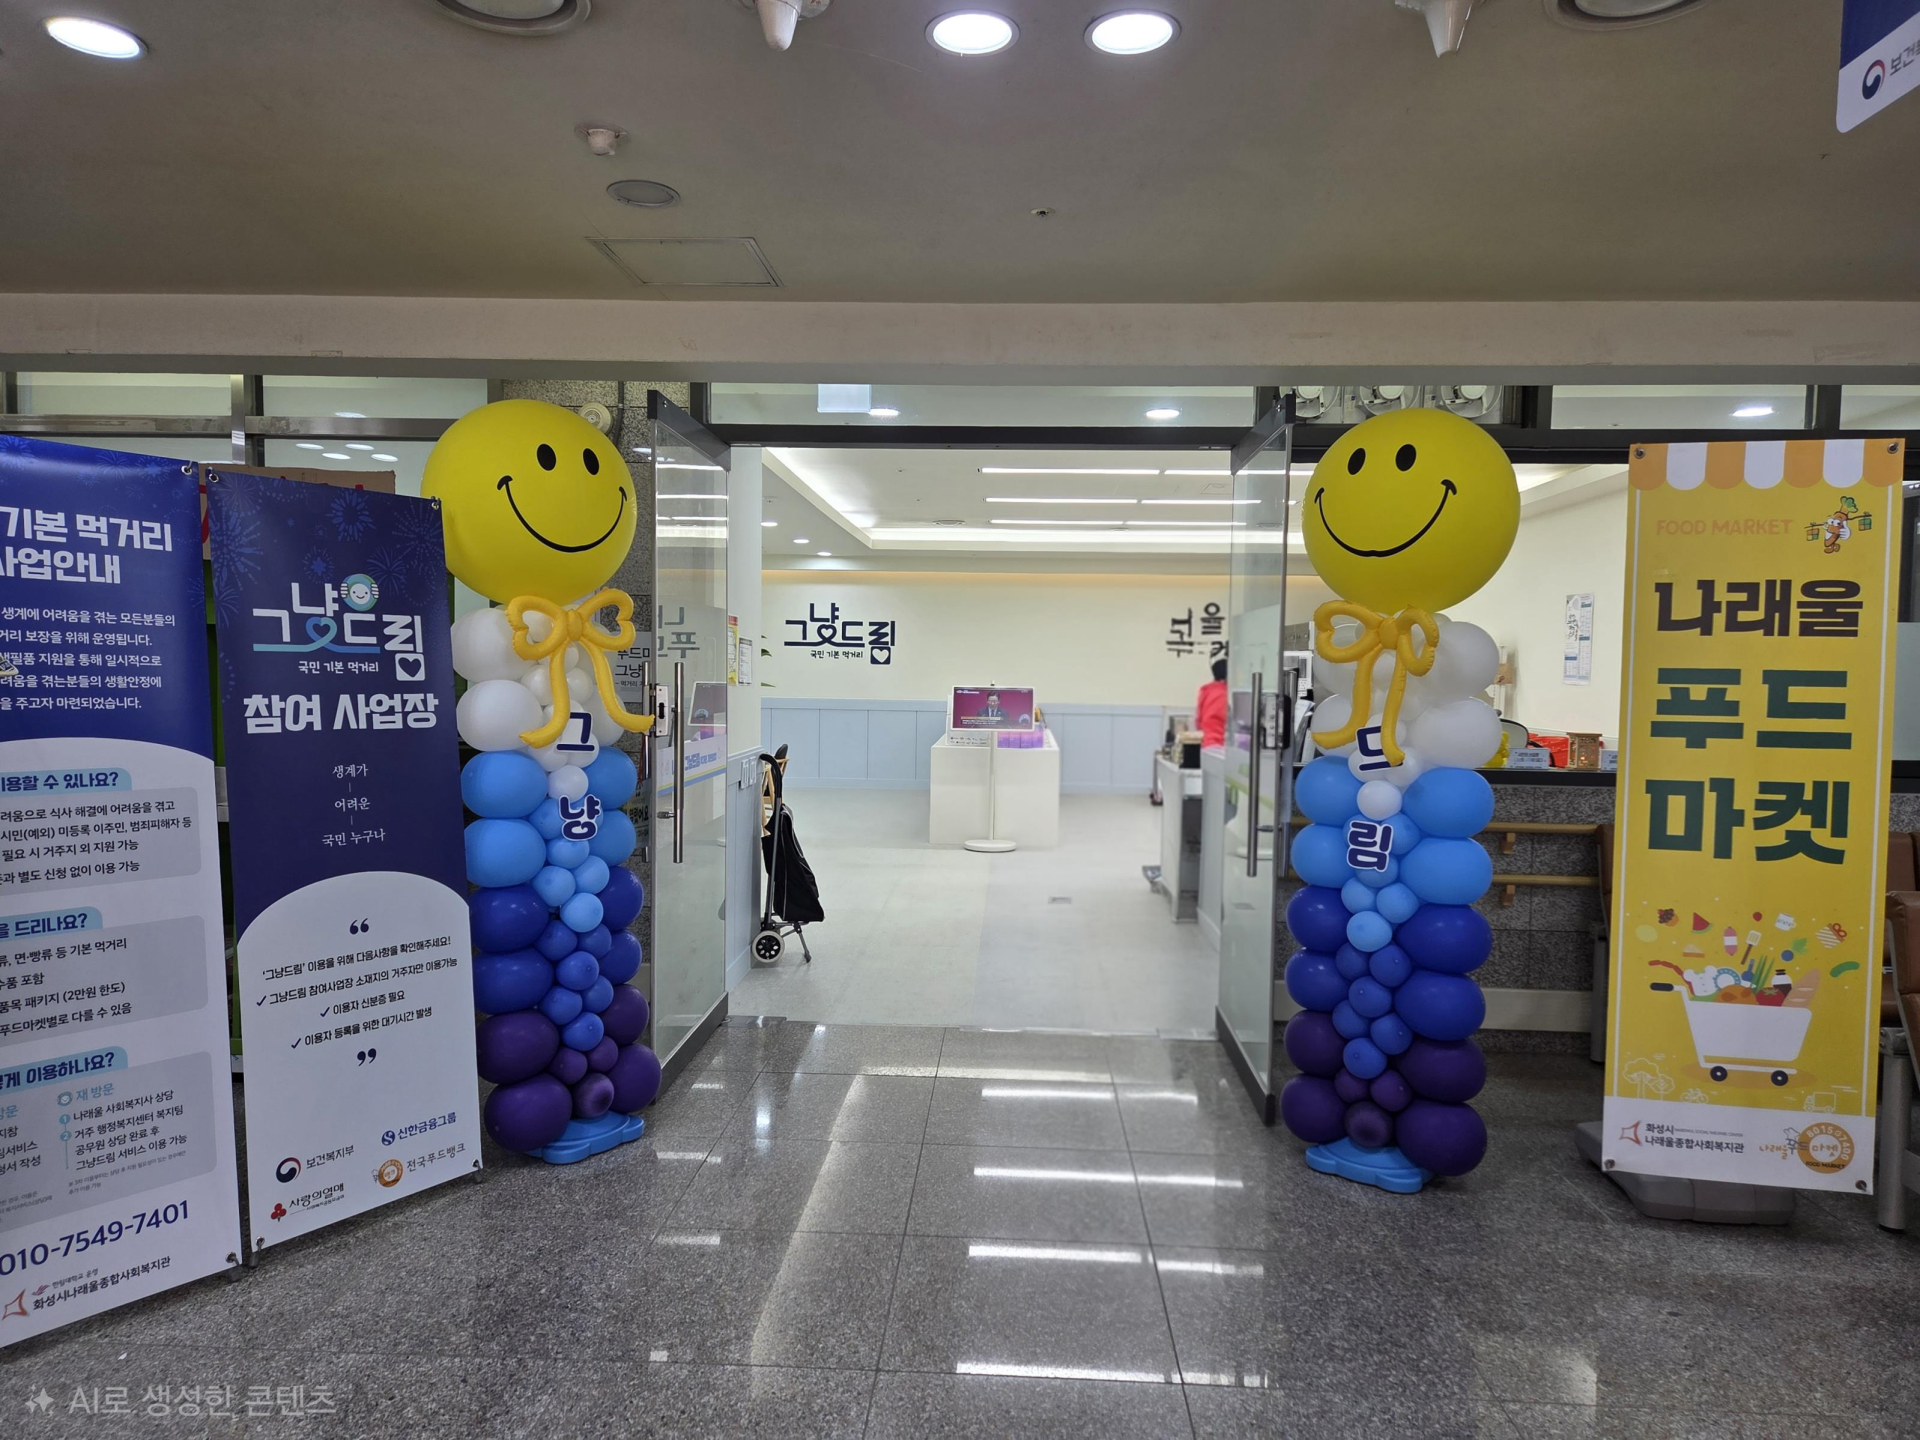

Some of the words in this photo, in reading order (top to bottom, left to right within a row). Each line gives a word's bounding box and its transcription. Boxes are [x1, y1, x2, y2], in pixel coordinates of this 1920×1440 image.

[0, 506, 68, 543] 기본
[76, 514, 172, 552] 먹거리
[1657, 519, 1706, 536] FOOD
[1711, 518, 1793, 536] MARKET
[2, 607, 40, 620] 생계에
[42, 609, 91, 622] 어려움을
[94, 611, 118, 624] 겪는
[120, 612, 175, 626] 모든분들의
[1654, 578, 1863, 637] 나래울
[25, 631, 62, 643] 보장을
[66, 632, 89, 644] 위해
[92, 633, 152, 646] 운영됩니다.
[252, 582, 426, 681] 그냥드림
[784, 602, 896, 665] 그냥드림
[39, 652, 75, 666] 지원을
[78, 654, 102, 666] 통해
[105, 654, 162, 666] 일시적으로
[810, 650, 824, 659] 국민
[827, 650, 840, 659] 기본
[842, 650, 863, 659] 먹거리
[298, 661, 320, 674] 국민
[324, 661, 344, 674] 기본
[348, 661, 379, 674] 먹거리
[42, 675, 101, 688] 겪는분들의
[105, 676, 162, 688] 생활안정에
[16, 698, 54, 710] 주고자
[57, 698, 142, 710] 마련되었습니다.
[243, 694, 322, 734] 참여
[333, 692, 439, 730] 사업장
[1650, 667, 1852, 750] 푸드
[43, 774, 59, 790] 수
[63, 771, 119, 789] 있나요?
[332, 764, 369, 779] 생계가
[50, 807, 72, 820] 식사
[75, 805, 108, 818] 해결에
[110, 801, 152, 815] 어려움을
[155, 800, 175, 812] 겪고
[334, 797, 370, 812] 어려운
[58, 825, 91, 837] 미등록
[93, 821, 127, 835] 이주민,
[130, 819, 180, 832] 범죄피해자
[182, 817, 192, 829] 등
[1645, 777, 1851, 865] 마켓
[322, 832, 346, 847] 국민
[350, 828, 386, 845] 누구나
[2, 848, 26, 861] 필요
[29, 847, 41, 859] 시
[43, 845, 77, 857] 거주지
[80, 843, 90, 855] 외
[93, 841, 115, 853] 지원
[118, 839, 139, 851] 가능
[18, 869, 40, 883] 별도
[45, 867, 67, 881] 신청
[70, 865, 91, 878] 없이
[95, 862, 116, 875] 이용
[119, 860, 140, 872] 가능
[15, 913, 88, 937] 드리나요?
[56, 946, 67, 959] 등
[70, 942, 92, 957] 기본
[95, 938, 127, 952] 먹거리
[308, 957, 335, 972] 이용을
[337, 952, 354, 966] 위해
[356, 945, 398, 964] 다음사항을
[400, 936, 451, 954] 확인해주세요!
[21, 972, 45, 986] 포함
[269, 986, 307, 1004] 그냥드림
[309, 978, 354, 998] 참여사업장
[356, 970, 389, 988] 소재지의
[391, 962, 424, 980] 거주자만
[426, 957, 458, 973] 이용가능
[25, 992, 59, 1009] 패키지
[63, 986, 97, 1003] (2만원
[99, 982, 126, 996] 한도)
[333, 999, 359, 1016] 이용자
[361, 994, 387, 1010] 신분증
[389, 989, 405, 1004] 필요
[72, 1009, 94, 1022] 다를
[97, 1008, 108, 1018] 수
[111, 1002, 132, 1017] 있음
[304, 1029, 332, 1046] 이용자
[334, 1022, 360, 1040] 등록을
[362, 1017, 379, 1032] 위한
[382, 1010, 414, 1028] 대기시간
[416, 1005, 432, 1020] 발생
[26, 1052, 114, 1085] 이용하나요?
[76, 1087, 89, 1101] 재
[91, 1083, 114, 1099] 방문
[74, 1106, 103, 1122] 나래울
[106, 1095, 153, 1115] 사회복지사
[155, 1089, 174, 1104] 상담
[75, 1126, 94, 1140] 거주
[97, 1112, 154, 1135] 행정복지센터
[157, 1104, 184, 1122] 복지팀
[398, 1111, 457, 1141] 신한금융그룹
[1645, 1122, 1675, 1135] 화성시
[75, 1140, 105, 1156] 공무원
[107, 1134, 126, 1148] 상담
[129, 1129, 148, 1143] 완료
[151, 1125, 160, 1137] 후
[76, 1154, 115, 1171] 그냥드림
[118, 1145, 146, 1163] 서비스
[149, 1139, 168, 1153] 이용
[170, 1134, 188, 1148] 가능
[1645, 1135, 1744, 1154] 나래울종합사회복지관
[20, 1154, 41, 1170] 작성
[306, 1144, 355, 1170] 보건복지부
[407, 1142, 466, 1173] 전국푸드뱅크
[289, 1182, 345, 1209] 사랑의열매
[0, 1199, 189, 1276] 010-7549-7401
[32, 1256, 171, 1311] 화성시나래울종합사회복지관
